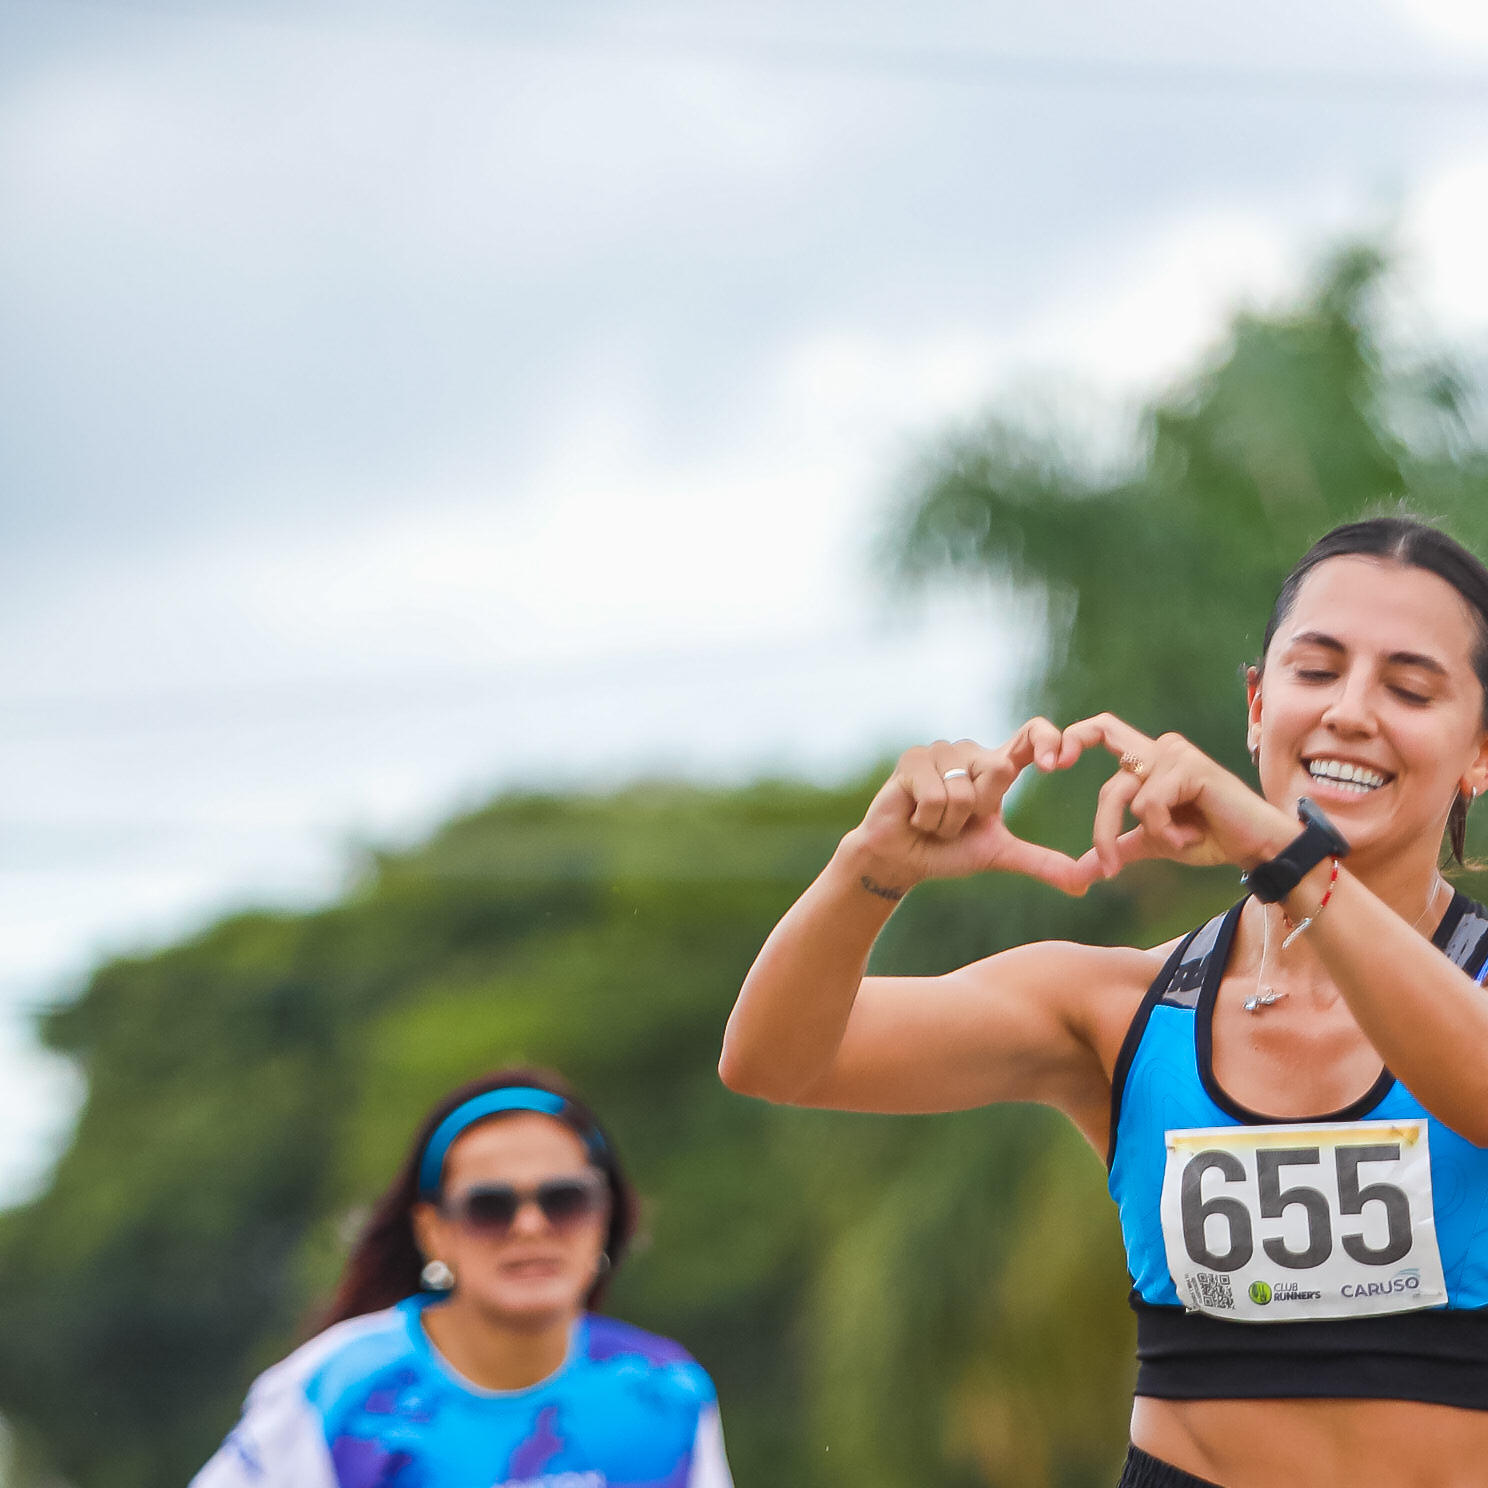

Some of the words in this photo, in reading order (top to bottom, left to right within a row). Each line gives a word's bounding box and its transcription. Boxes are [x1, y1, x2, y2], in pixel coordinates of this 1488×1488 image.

[1181, 1143, 1413, 1272] 655
[1273, 1282, 1298, 1292] CLUB
[1340, 1276, 1419, 1298] CARUSO
[1273, 1291, 1321, 1302] RUNNER'S
